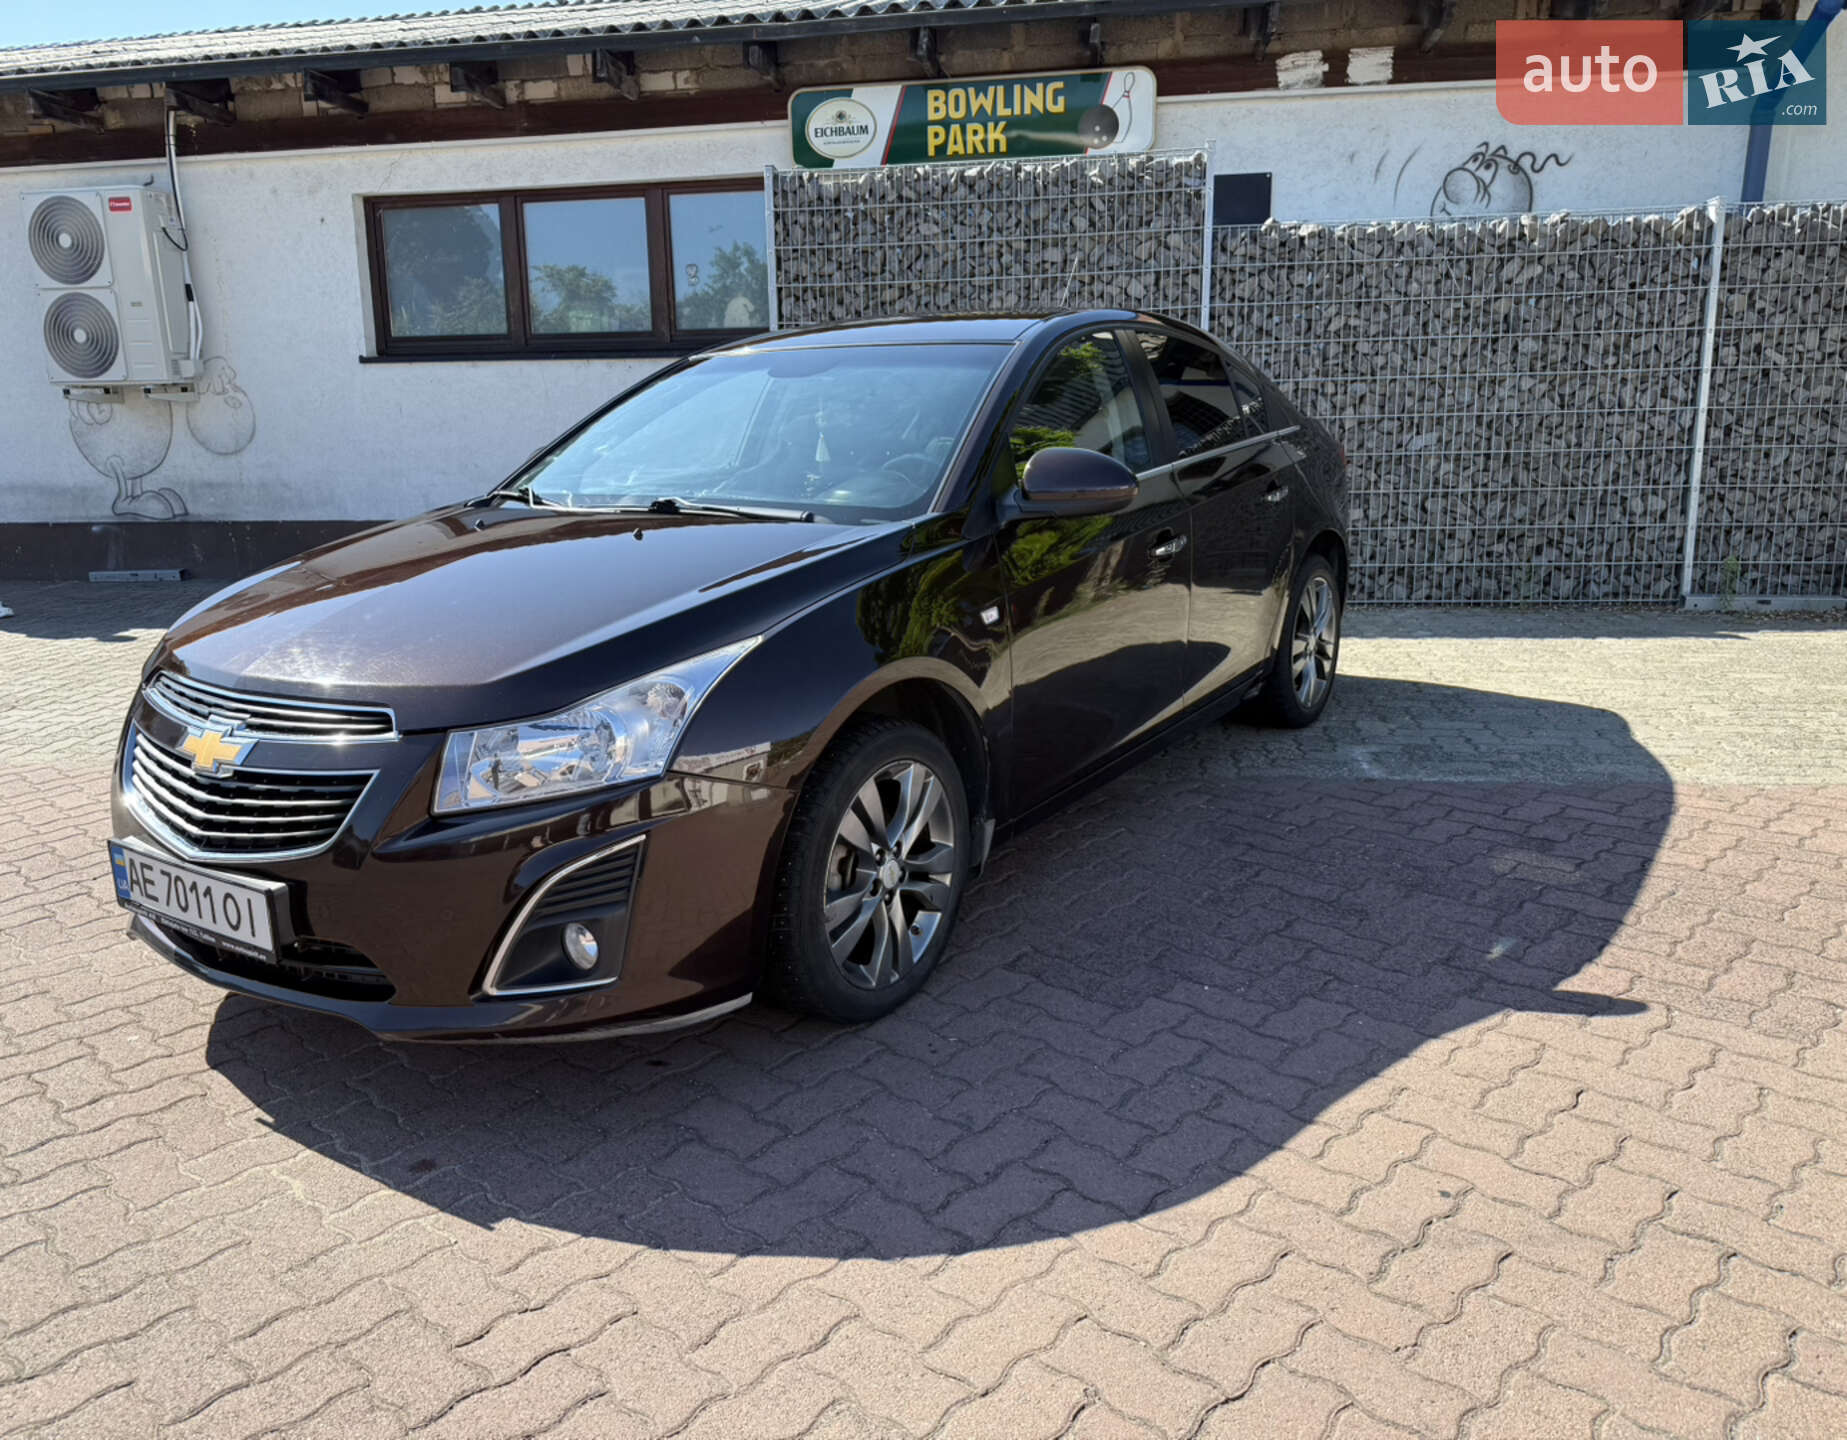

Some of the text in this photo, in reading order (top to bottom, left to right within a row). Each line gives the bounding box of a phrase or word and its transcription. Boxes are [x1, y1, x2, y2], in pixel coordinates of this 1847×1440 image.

[927, 82, 1065, 121] BOWLING
[814, 124, 869, 138] EICHBAUM
[927, 121, 1008, 157] PARK
[129, 858, 159, 903] AE
[160, 869, 217, 925] 7011
